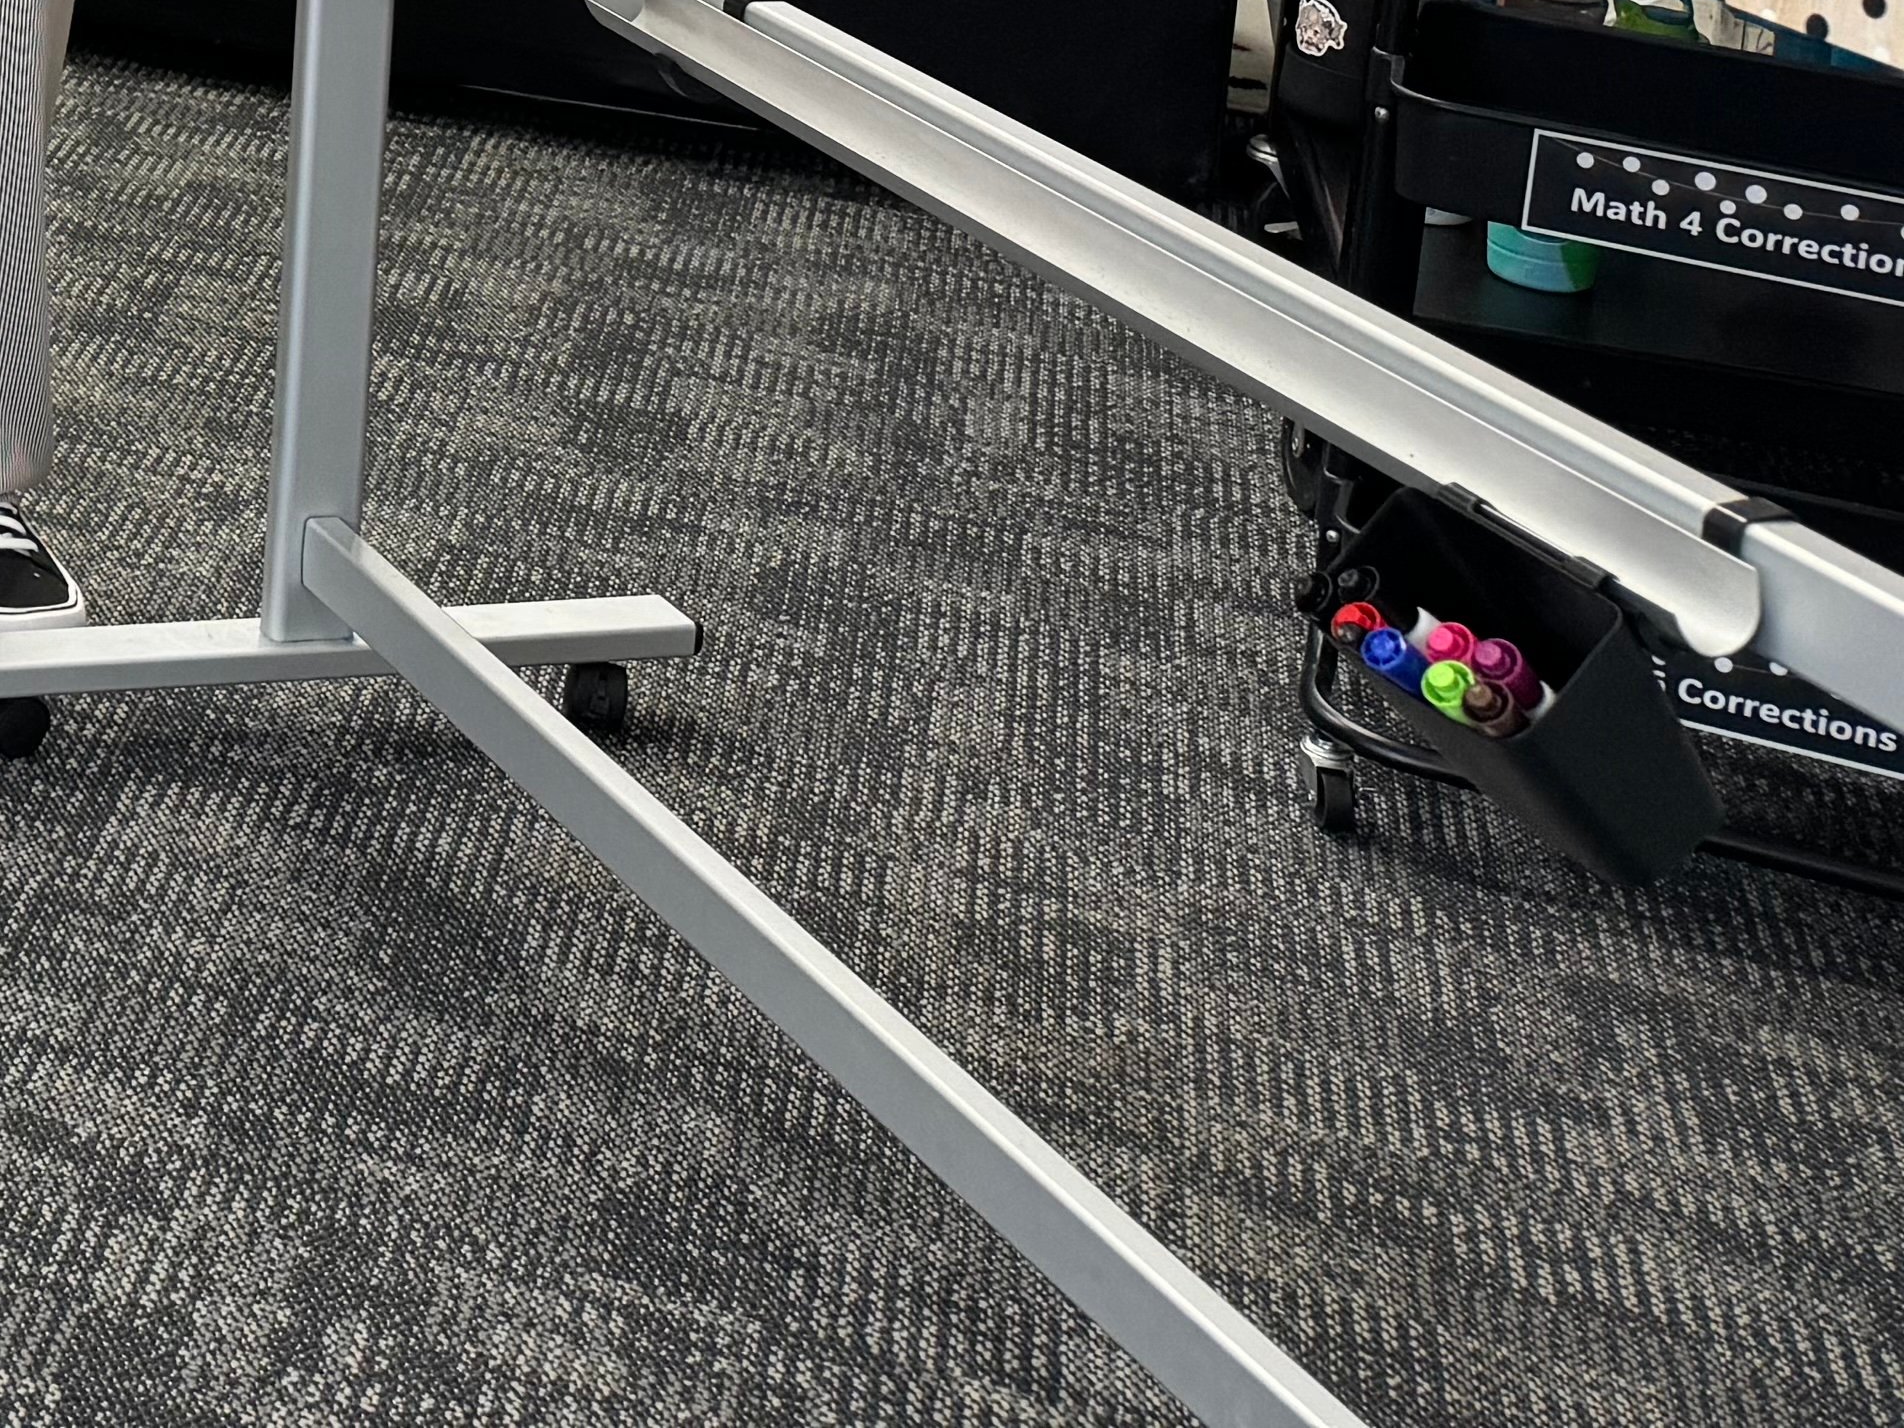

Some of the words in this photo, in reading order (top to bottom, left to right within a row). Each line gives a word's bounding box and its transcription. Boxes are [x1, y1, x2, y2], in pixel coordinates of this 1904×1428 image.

[1570, 187, 1667, 230] Math
[1679, 210, 1703, 236] 4
[1677, 677, 1898, 752] Corrections
